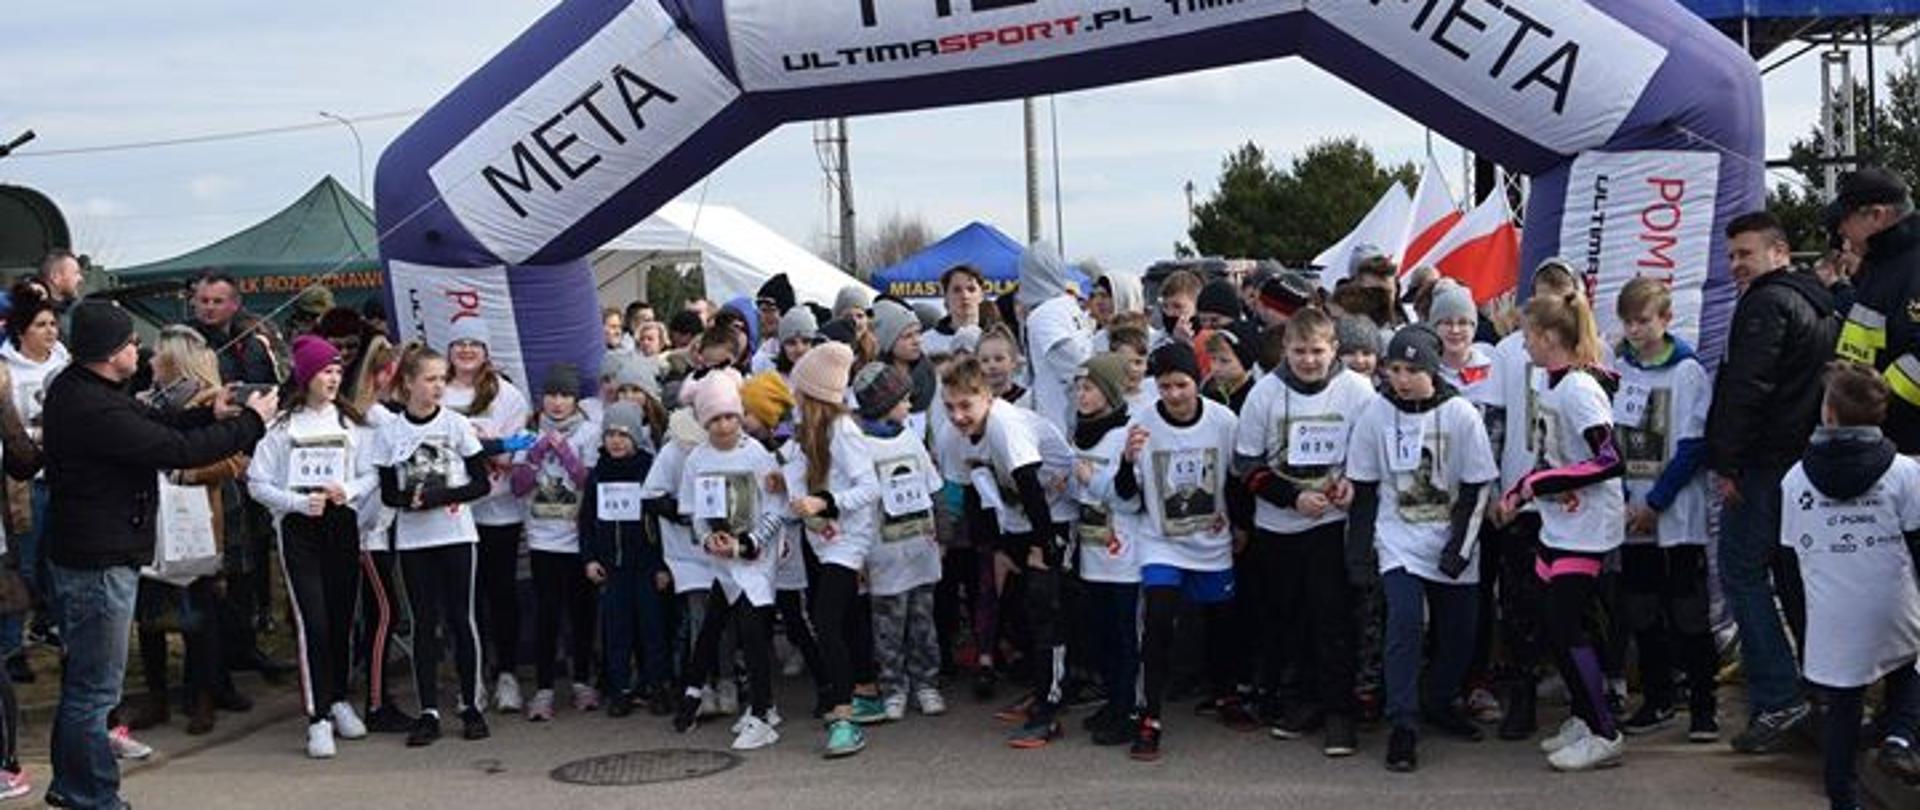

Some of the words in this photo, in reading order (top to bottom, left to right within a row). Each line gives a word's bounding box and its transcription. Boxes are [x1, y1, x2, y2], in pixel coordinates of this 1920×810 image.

[783, 7, 1152, 71] ULTIMASPORT.PL
[481, 64, 678, 219] META
[1636, 178, 1685, 286] POM
